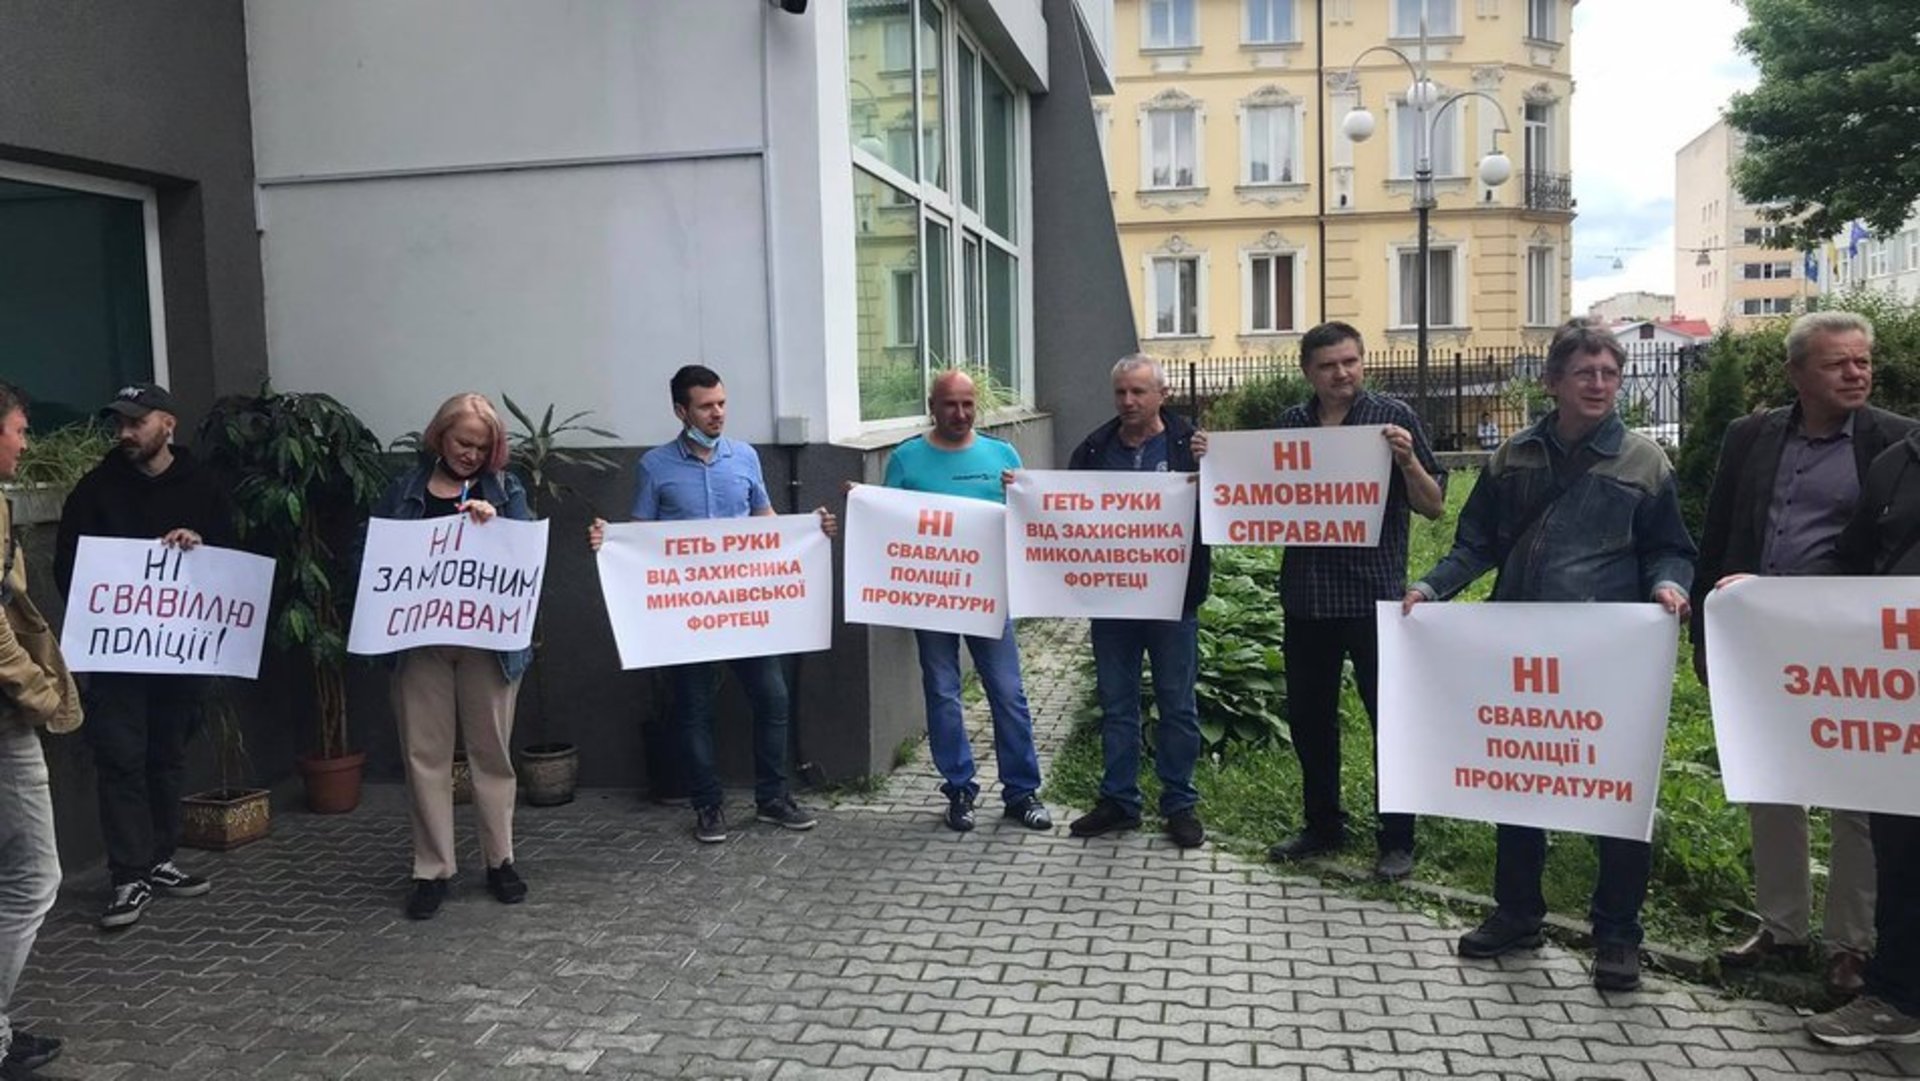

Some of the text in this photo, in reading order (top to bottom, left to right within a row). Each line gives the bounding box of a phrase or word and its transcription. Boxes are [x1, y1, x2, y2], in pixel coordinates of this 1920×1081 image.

[1273, 440, 1312, 471] НІ
[1042, 492, 1161, 512] ГЕТЬ РУКИ
[1214, 481, 1380, 506] ЗАМОВНИМ
[429, 515, 466, 557] НІ
[917, 509, 953, 538] НІ
[1026, 522, 1184, 541] ВІД ЗАХИСНИКА
[1229, 520, 1366, 544] СПРАВАМ
[664, 532, 780, 556] ГЕТЬ РУКИ
[886, 542, 980, 565] СВАВЛЛЮ
[144, 548, 182, 581] НІ
[372, 558, 541, 598] ЗАМОВНИМ
[646, 559, 802, 586] ВІД ЗАХИСНИКА
[890, 566, 972, 588] ПОЛІЦІЇ І
[1064, 571, 1148, 590] ФОРТЕЦІ
[88, 583, 256, 630] СВАВІЛЛЮ
[862, 588, 996, 614] ПРОКУРАТУРИ
[386, 598, 533, 638] СПРАВАМ!
[686, 609, 770, 631] ФОРТЕЦІ
[88, 624, 227, 665] ПОЛІЦІЇ!
[1513, 656, 1560, 694] НІ
[1783, 664, 1920, 701] ЗАМО
[1477, 705, 1603, 732] СВАВЛЛЮ
[1486, 737, 1596, 766] ПОЛІЦІЇ І
[1455, 768, 1633, 803] ПРОКУРАТУРИ
